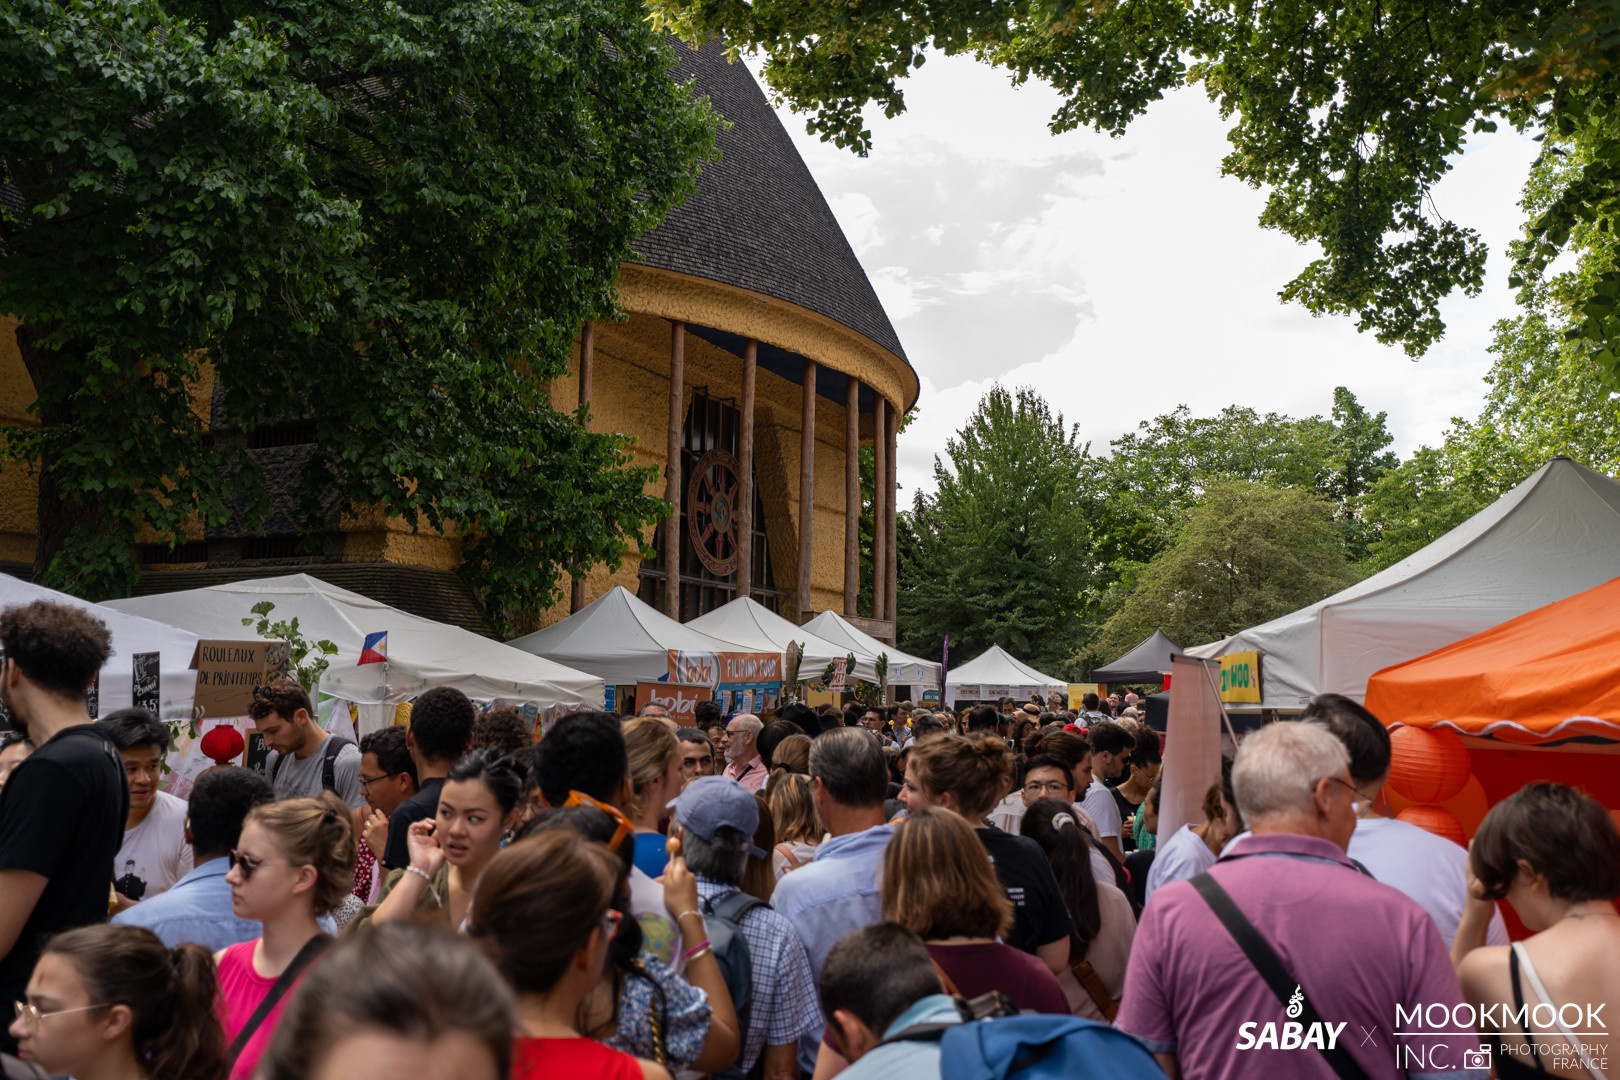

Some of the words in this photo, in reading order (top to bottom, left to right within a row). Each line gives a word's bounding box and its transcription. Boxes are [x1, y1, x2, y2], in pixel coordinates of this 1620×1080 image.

[202, 646, 255, 663] ROULEAUX
[685, 656, 713, 683] bobi
[727, 659, 757, 678] FILIPINO
[759, 658, 776, 677] FOOD
[200, 671, 209, 685] DE
